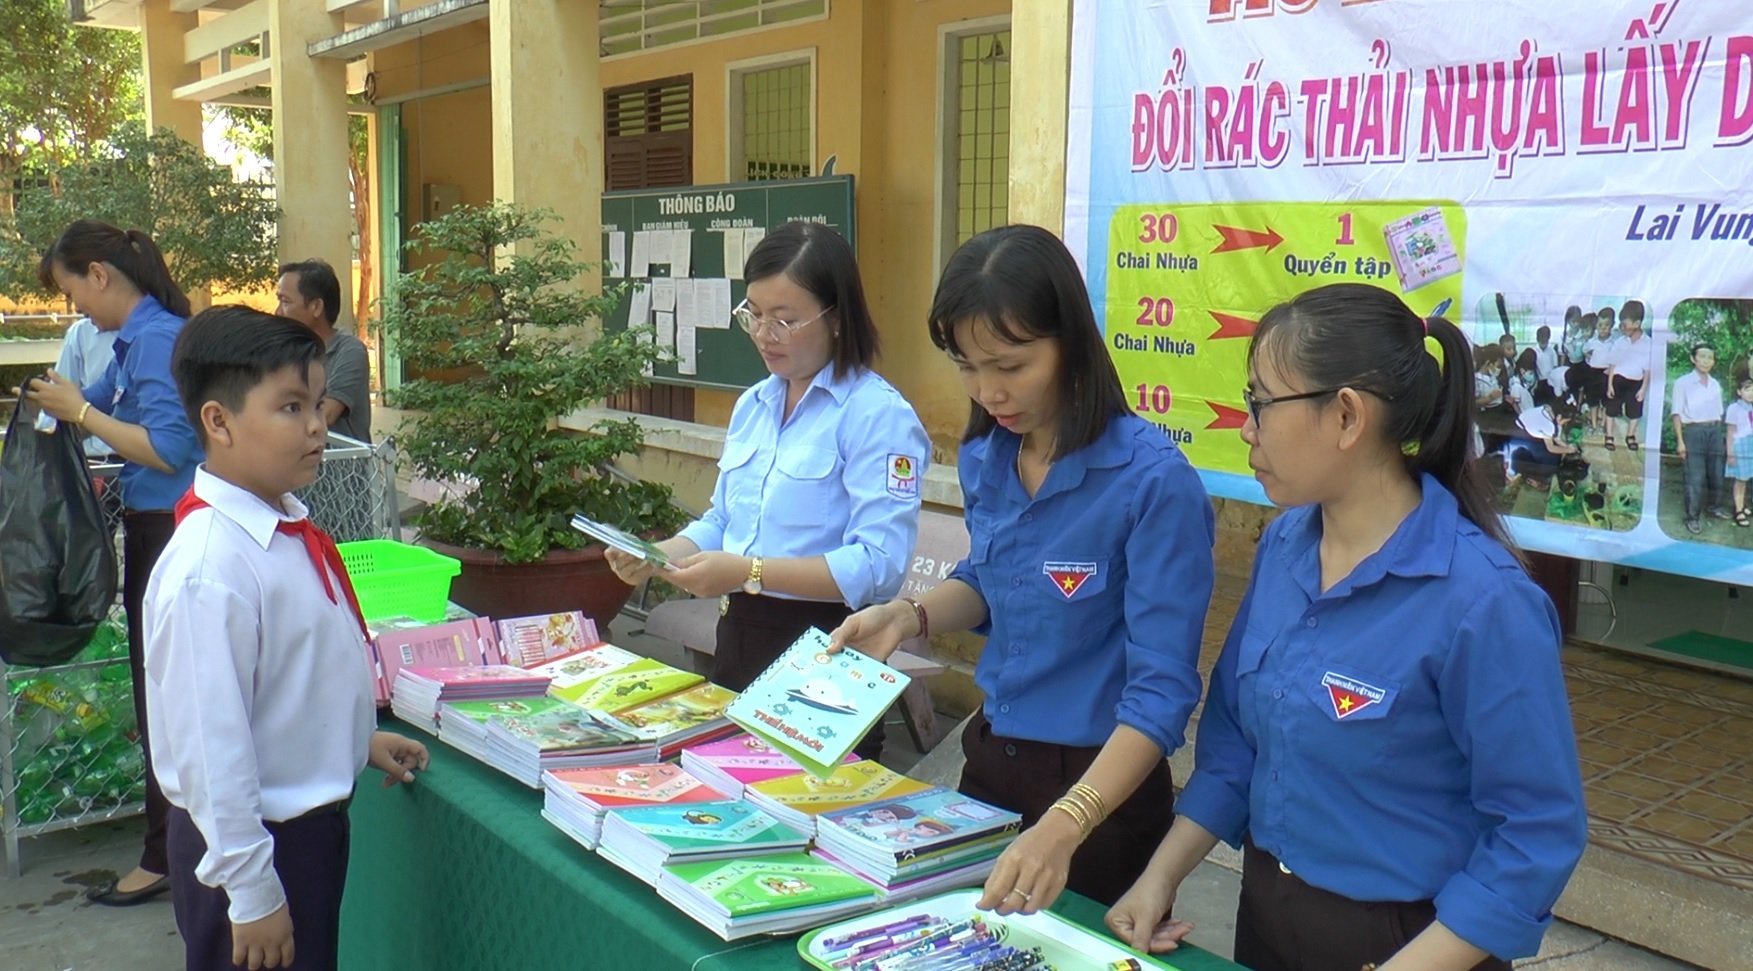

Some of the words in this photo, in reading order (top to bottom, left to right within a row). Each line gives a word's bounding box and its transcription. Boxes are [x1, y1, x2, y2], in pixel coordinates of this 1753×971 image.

[1131, 48, 1195, 172] ĐỔI
[1203, 59, 1291, 170] RÁC
[1298, 38, 1412, 166] THẢI
[1417, 39, 1566, 178] NHỰA
[1576, 0, 1711, 155] LẤY
[658, 194, 703, 215] THÔNG
[705, 191, 736, 213] BÁO
[710, 218, 731, 228] CÔNG
[1138, 213, 1178, 244] 30
[1334, 212, 1356, 246] 1
[1624, 203, 1686, 242] Lai
[1690, 203, 1753, 247] Vun
[1116, 252, 1151, 270] Chai
[1156, 252, 1199, 274] Nhựa
[1284, 252, 1347, 277] Quyển
[1354, 257, 1392, 279] tập
[1136, 296, 1175, 328] 20
[1113, 333, 1148, 352] Chai
[1152, 335, 1196, 358] Nhựa
[1134, 383, 1172, 415] 10
[911, 555, 936, 577] 23
